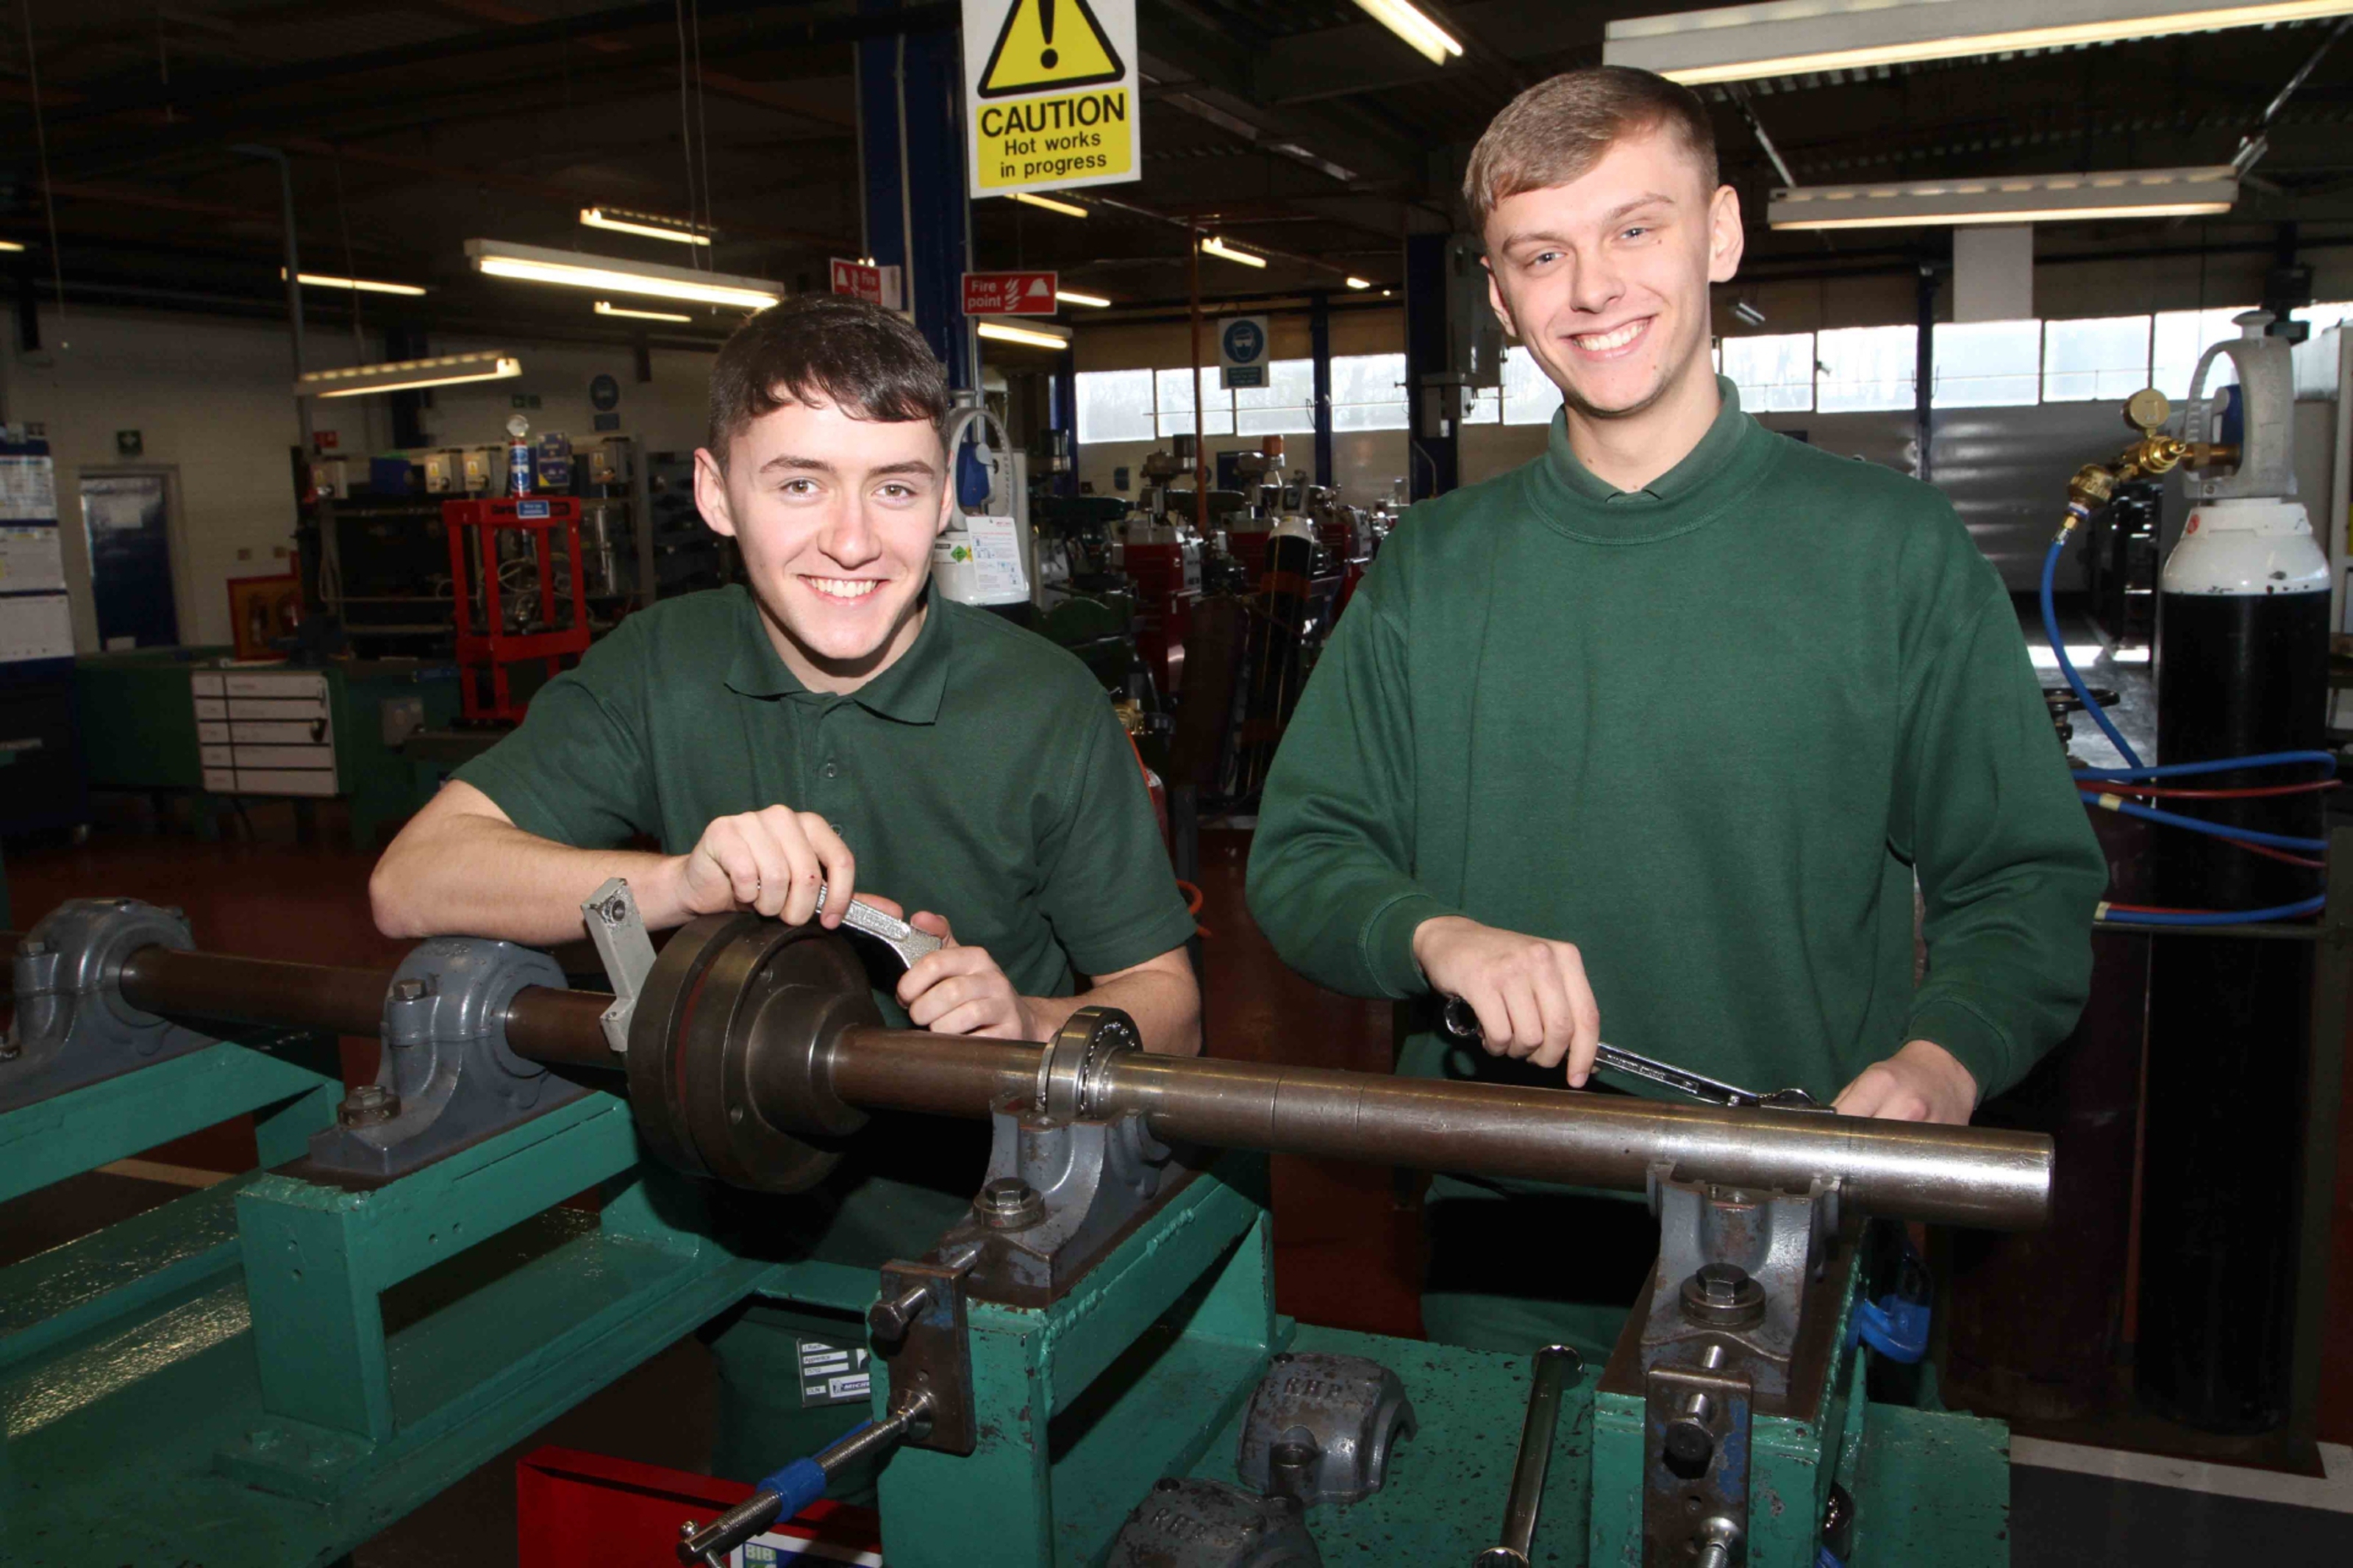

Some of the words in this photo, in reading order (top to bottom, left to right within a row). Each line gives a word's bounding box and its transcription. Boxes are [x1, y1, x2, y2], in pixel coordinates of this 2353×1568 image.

[981, 93, 1125, 137] CAUTION
[1004, 137, 1036, 157] Hot
[1045, 131, 1101, 151] works
[1000, 161, 1015, 178] in
[1024, 154, 1107, 179] progress
[971, 280, 997, 293] Fire
[968, 295, 1001, 310] point
